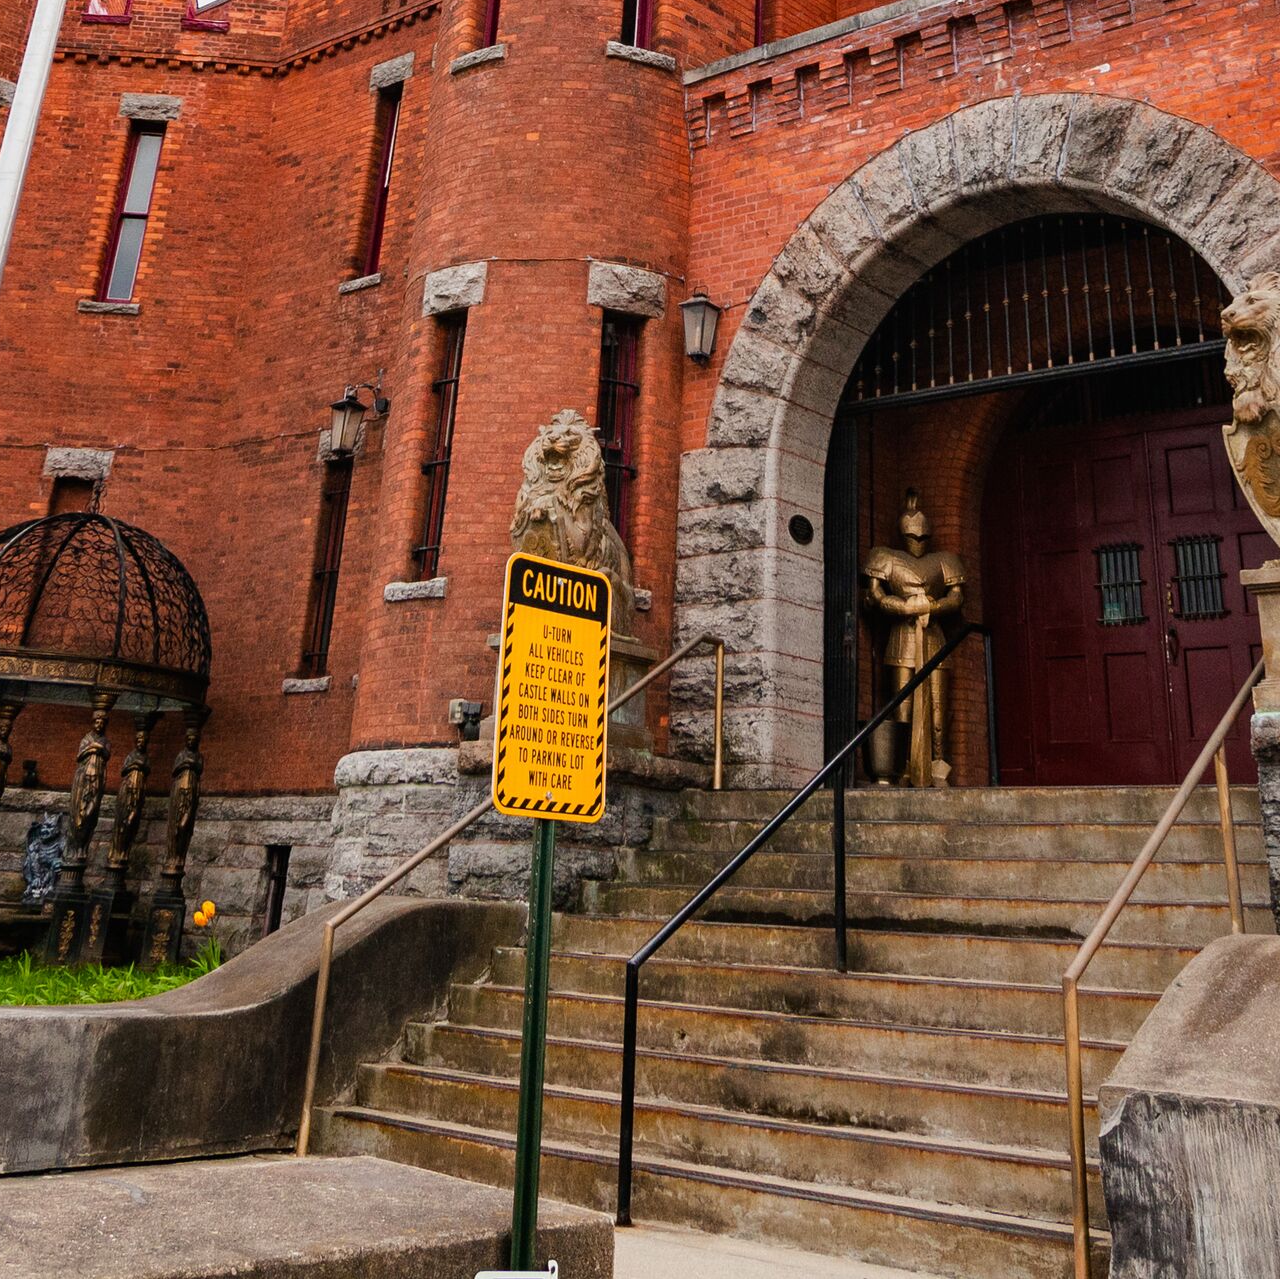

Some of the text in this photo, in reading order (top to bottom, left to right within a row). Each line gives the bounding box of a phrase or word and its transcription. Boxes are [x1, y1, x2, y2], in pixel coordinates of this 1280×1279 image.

[522, 569, 597, 612] CAUTION
[543, 624, 572, 644] U-TURN
[528, 642, 584, 666] ALL VEHICLES
[525, 662, 586, 687] KEEP CLEAR OF
[519, 682, 590, 708] CASTLE WALLS ON
[518, 704, 588, 728] BOTH SIDES TURN
[509, 724, 594, 750] AROUND OR REVERSE
[519, 747, 584, 770] TO PARKING LOT
[528, 770, 572, 790] WITH CARE
